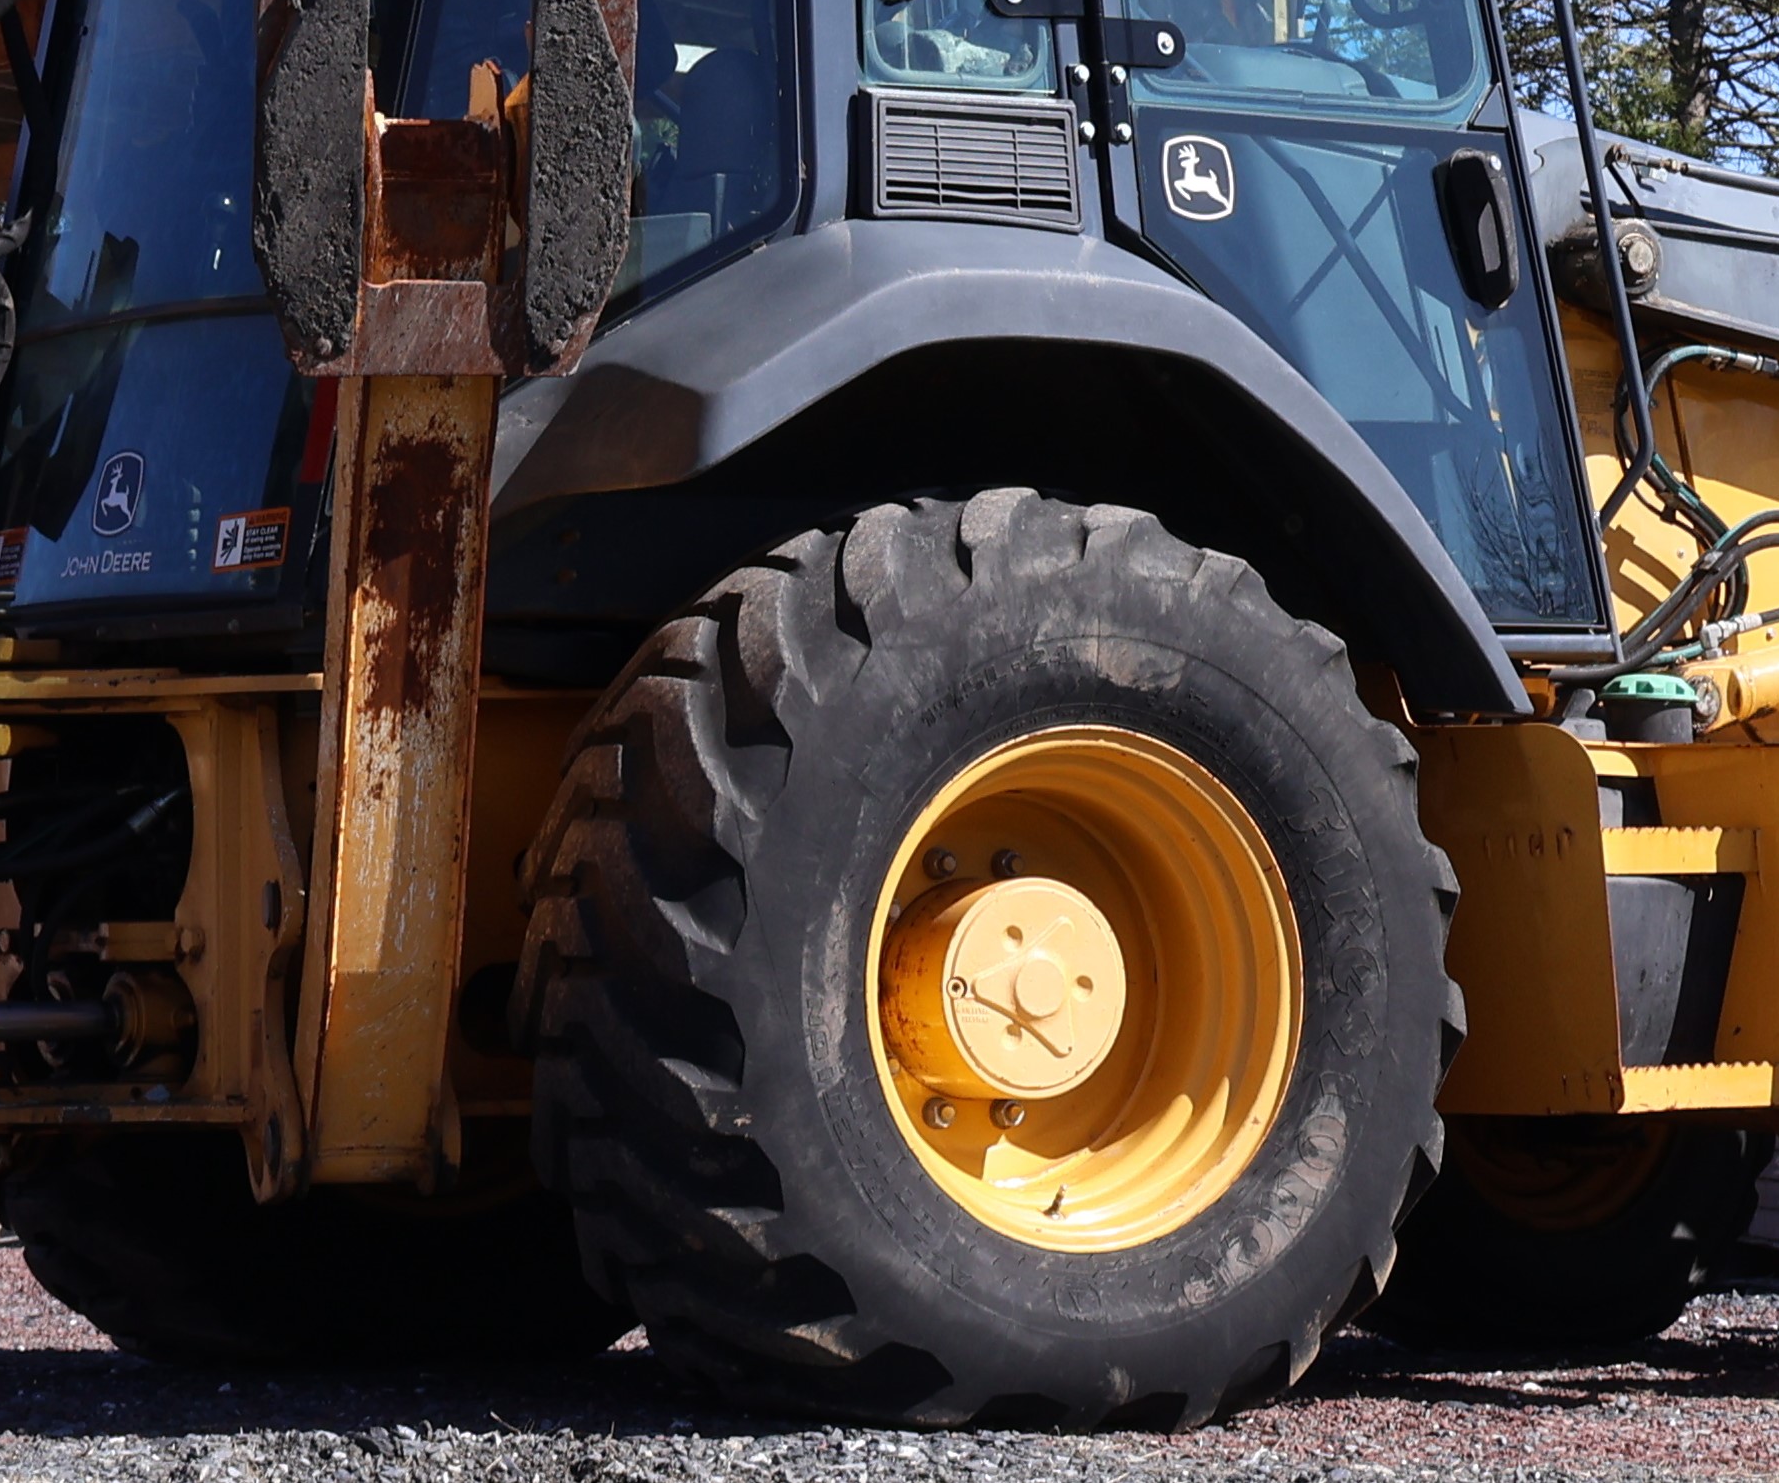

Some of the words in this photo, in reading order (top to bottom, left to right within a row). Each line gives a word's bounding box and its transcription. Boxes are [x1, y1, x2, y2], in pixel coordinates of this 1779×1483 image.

[246, 528, 259, 537] STAY
[260, 526, 279, 535] CLEAR
[60, 554, 100, 578] JOHN
[101, 550, 152, 574] DEERE
[806, 996, 903, 1228] TRACTION
